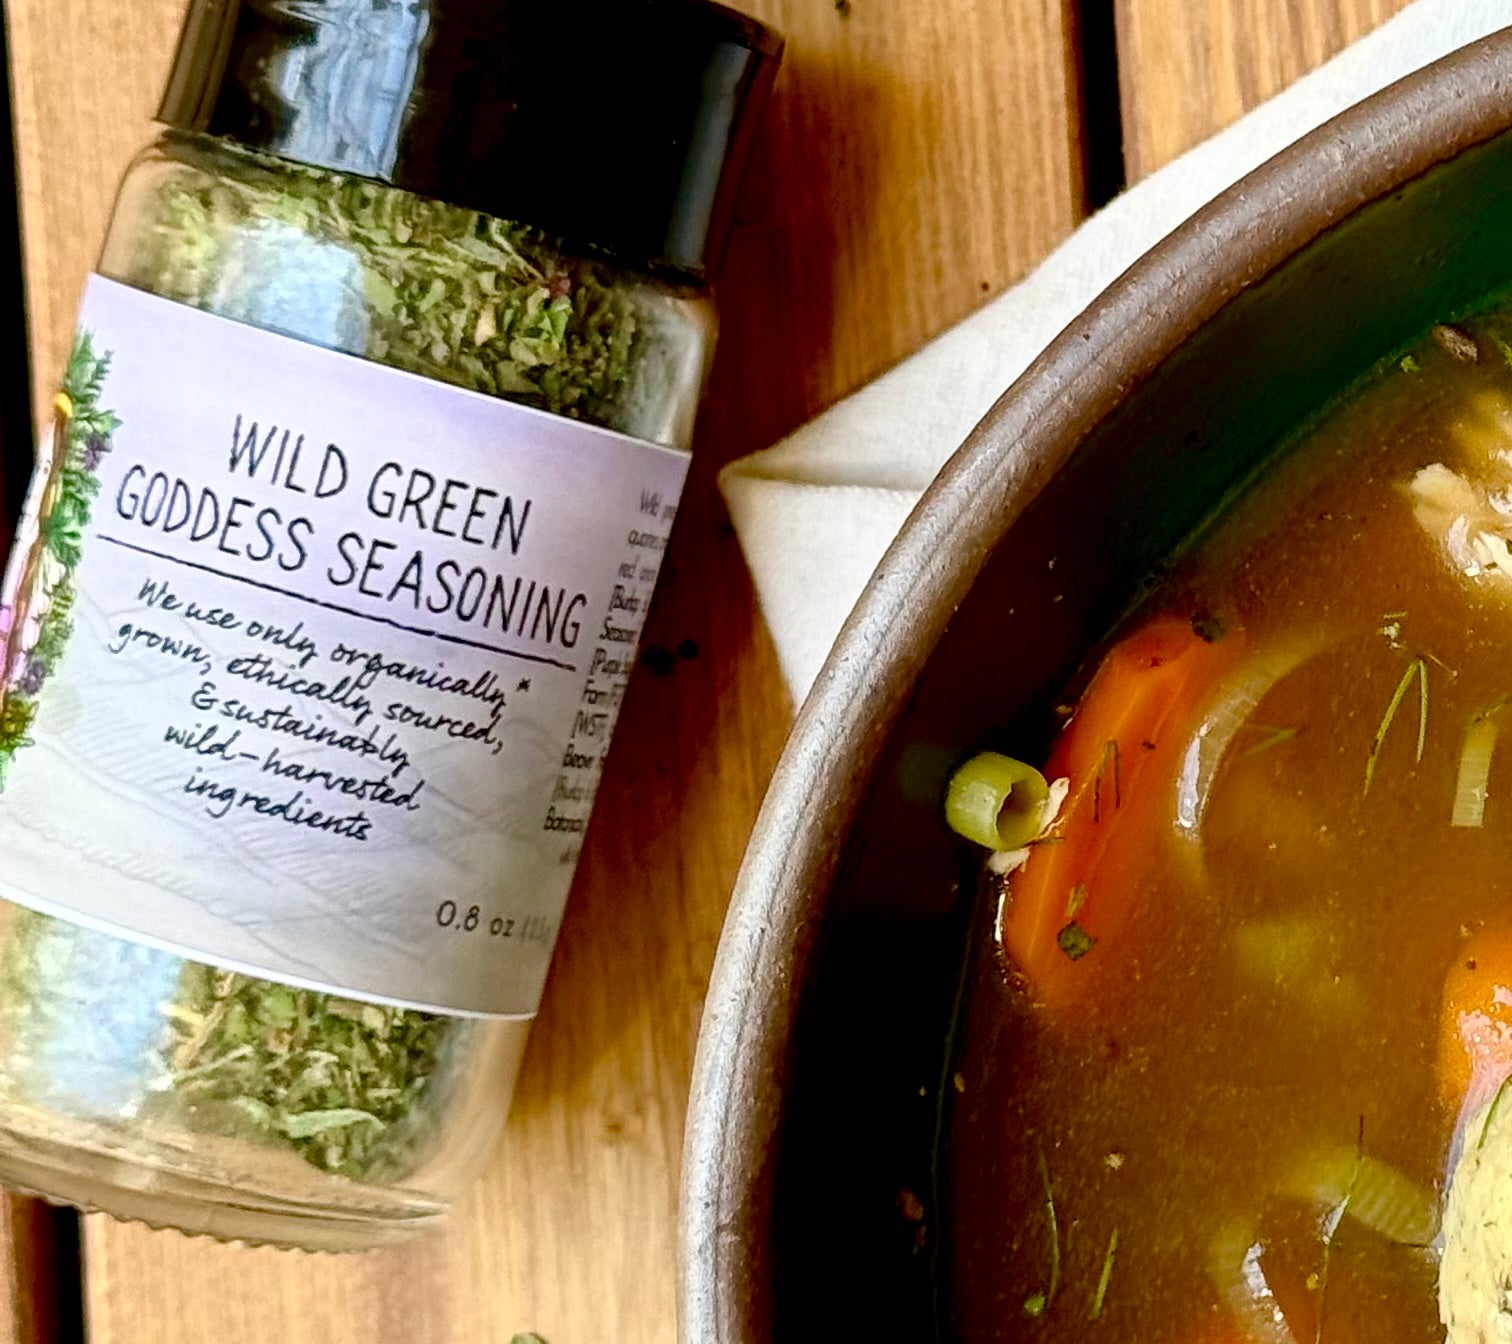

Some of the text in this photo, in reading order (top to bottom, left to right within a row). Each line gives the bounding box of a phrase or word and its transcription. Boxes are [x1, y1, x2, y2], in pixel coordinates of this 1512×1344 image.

[229, 414, 532, 555] WILD GREEN
[116, 464, 588, 648] GODDESS SEASONING
[137, 577, 181, 611] We
[184, 601, 242, 630] use
[247, 622, 319, 667] only
[109, 622, 213, 675] grown,
[227, 654, 372, 726] ethically
[383, 699, 505, 755] sourced,
[164, 723, 425, 812] wild-harvested
[219, 698, 410, 776] sustainably
[184, 766, 375, 842] ingredients
[436, 899, 480, 932] 0.8
[489, 916, 516, 938] oz
